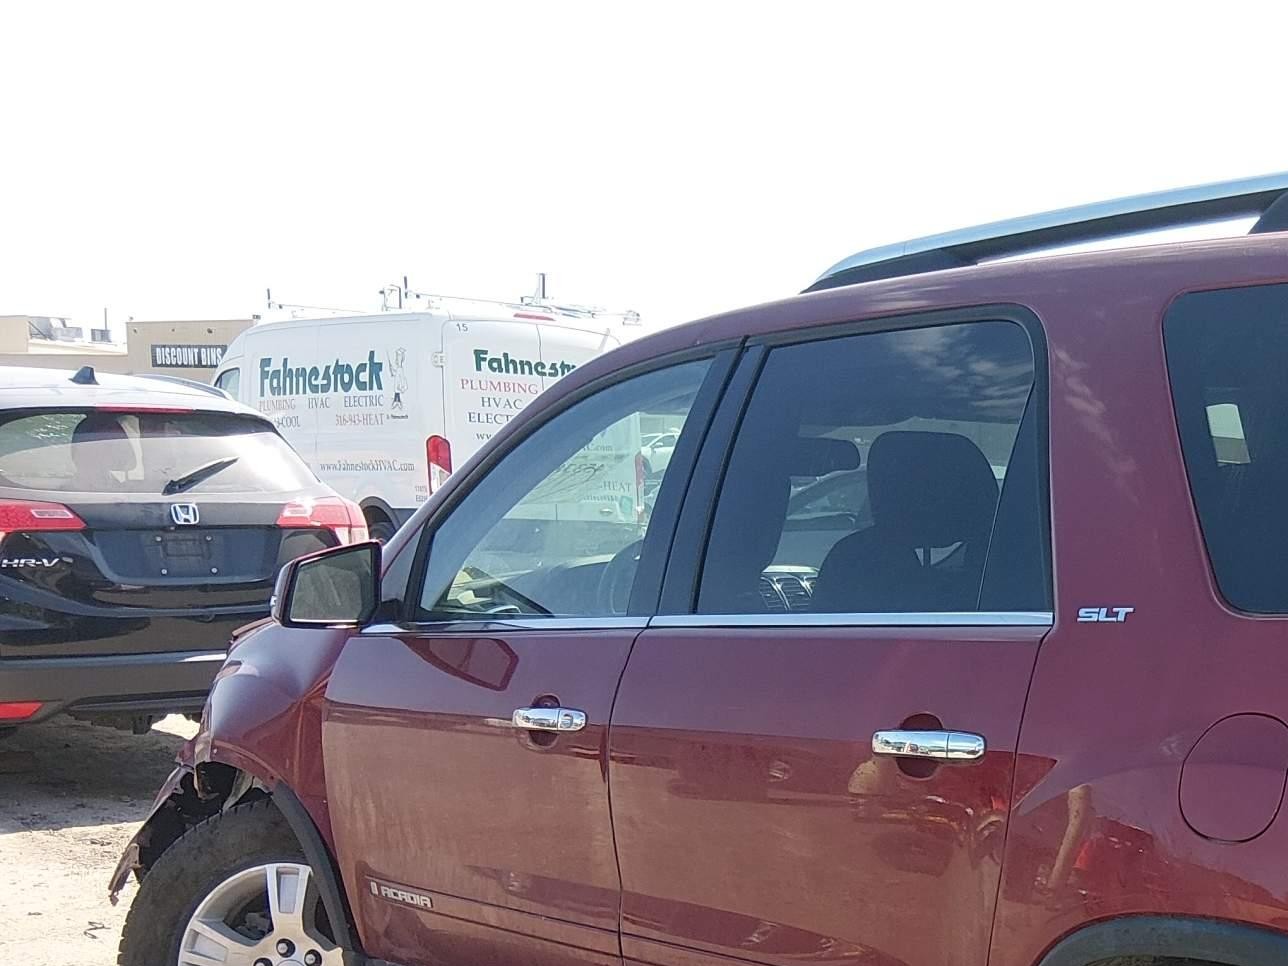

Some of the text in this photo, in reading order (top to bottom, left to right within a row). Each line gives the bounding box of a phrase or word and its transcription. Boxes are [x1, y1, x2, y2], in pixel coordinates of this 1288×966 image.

[456, 323, 468, 332] 15
[156, 347, 223, 366] DISCOUNT BINS
[473, 349, 577, 378] Fahnest
[259, 350, 383, 398] Fahnestock
[460, 379, 538, 395] PLUMBING
[343, 394, 385, 408] ELECTRIC
[481, 396, 523, 410] HVAC
[1, 558, 60, 568] HR-V
[1076, 607, 1134, 622] SLT
[380, 885, 433, 908] ACADIA
